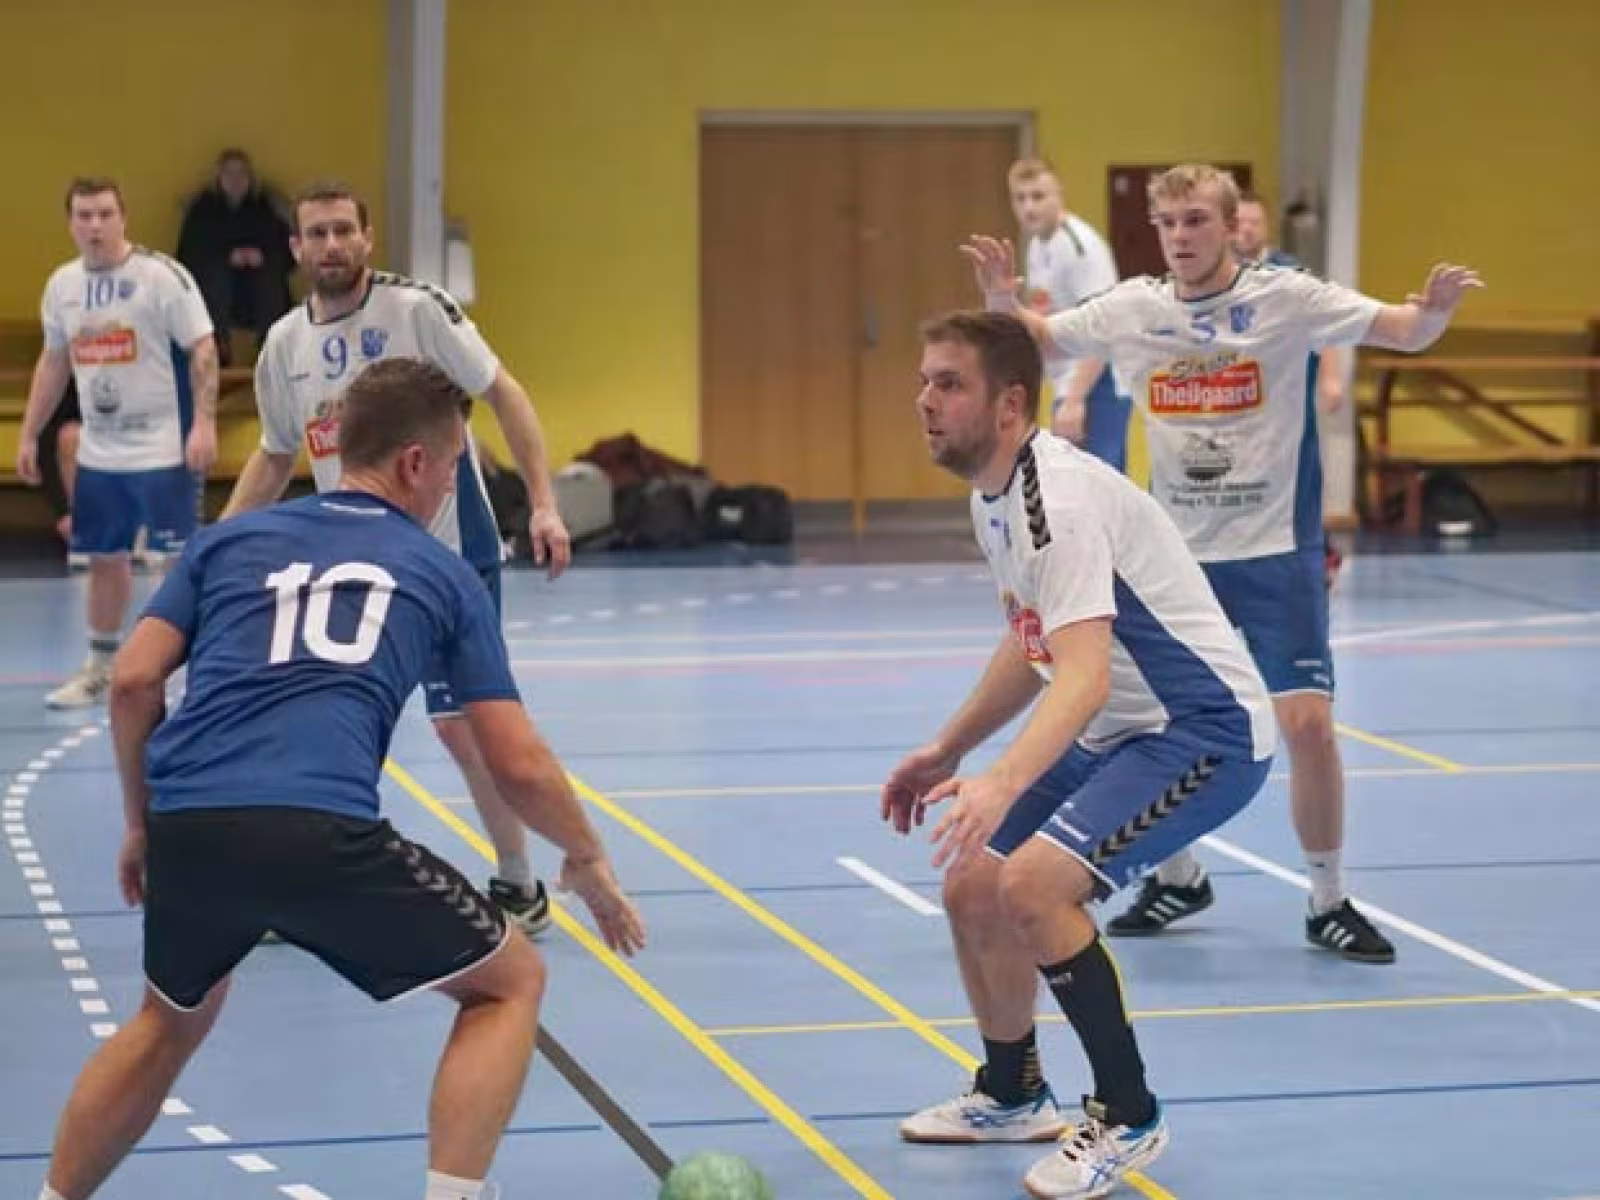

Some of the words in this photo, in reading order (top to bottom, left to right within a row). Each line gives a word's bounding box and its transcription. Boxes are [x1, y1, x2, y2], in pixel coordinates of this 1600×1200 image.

[83, 277, 115, 310] 10
[1190, 310, 1217, 345] 5
[321, 335, 348, 381] 9
[265, 561, 398, 664] 10
